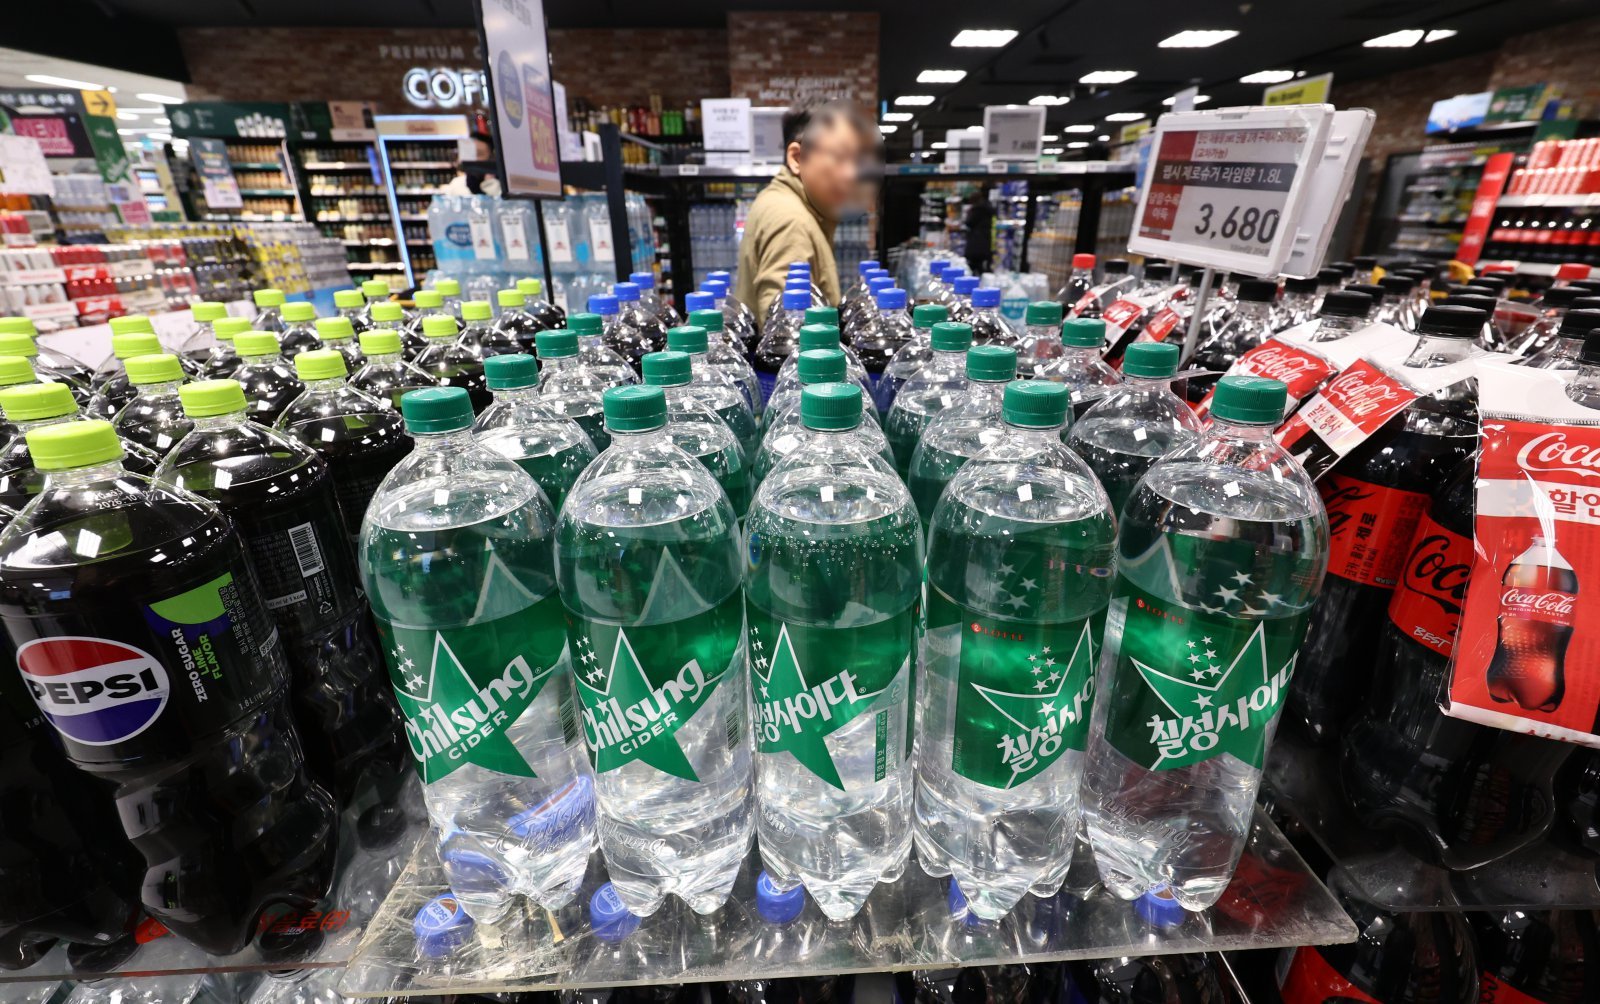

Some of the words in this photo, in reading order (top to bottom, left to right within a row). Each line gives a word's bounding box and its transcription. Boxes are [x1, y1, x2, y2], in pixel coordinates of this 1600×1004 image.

[379, 45, 464, 60] PREMIUM
[403, 67, 487, 108] COF
[1163, 165, 1183, 184] 펩시
[1183, 166, 1221, 184] 제로슈거
[1222, 166, 1255, 185] 라임향
[1257, 167, 1282, 184] 1.8L
[1195, 203, 1280, 244] 3,680
[1329, 370, 1399, 417] Coca-Cola
[1308, 404, 1329, 424] 할인
[1320, 415, 1344, 436] 행사
[1356, 512, 1377, 541] 제로
[1502, 588, 1577, 615] Coca-Cola
[1507, 606, 1540, 614] ORIGINAL
[1543, 610, 1565, 618] TASTE
[168, 627, 195, 672] SUGAR
[982, 627, 1025, 642] LOTTE
[1413, 625, 1452, 648] BEST
[192, 647, 210, 676] LIME
[198, 634, 223, 680] FLAVOR
[27, 667, 159, 705] PEPSI
[189, 671, 209, 703] ZERO
[405, 655, 533, 762] Chilsung
[581, 658, 705, 752] Chilsung
[997, 665, 1100, 773] 칠성사이
[1146, 650, 1299, 759] 칠성사이다
[448, 710, 509, 760] CIDER
[619, 711, 679, 755] CIDER
[428, 901, 450, 924] PEPSI
[603, 884, 623, 910] PEPSI
